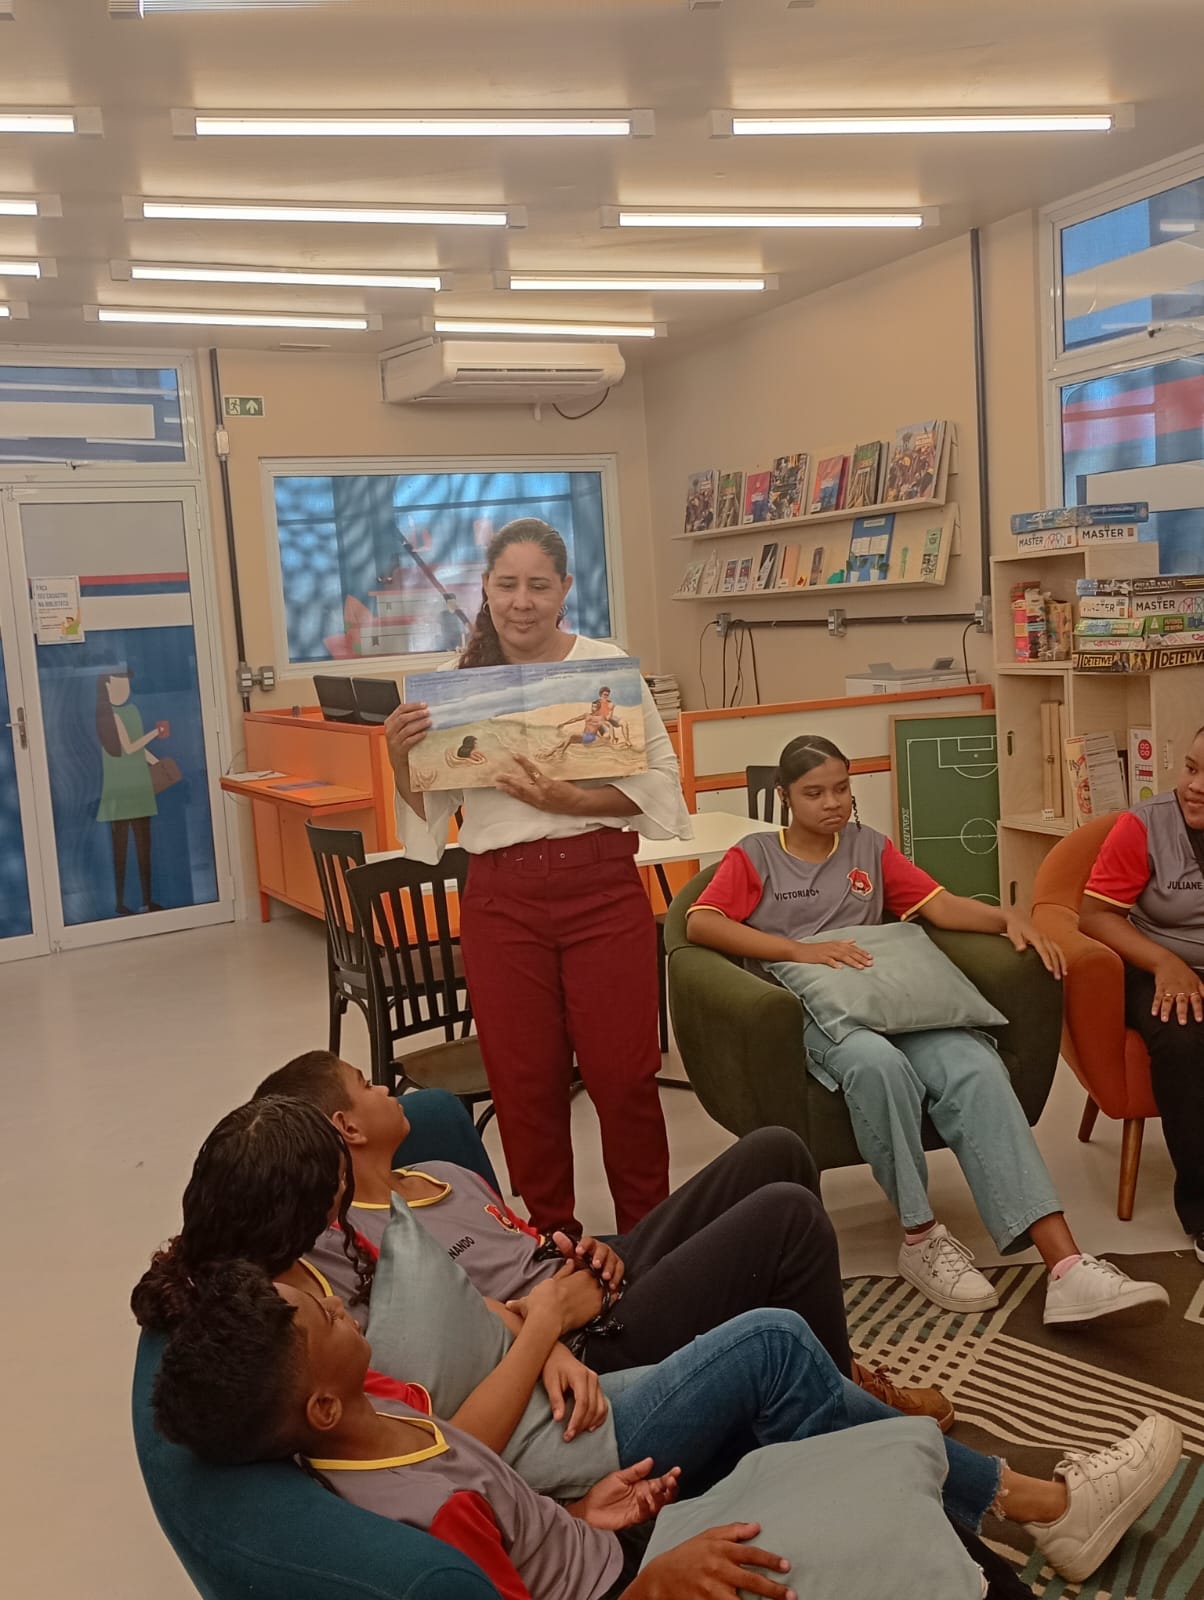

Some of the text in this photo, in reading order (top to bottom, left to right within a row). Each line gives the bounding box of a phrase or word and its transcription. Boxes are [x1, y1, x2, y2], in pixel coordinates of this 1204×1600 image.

[1082, 528, 1124, 539] MASTER
[1019, 536, 1044, 548] MASTER
[1136, 600, 1175, 611] MASTER
[1167, 881, 1203, 890] JULIANE
